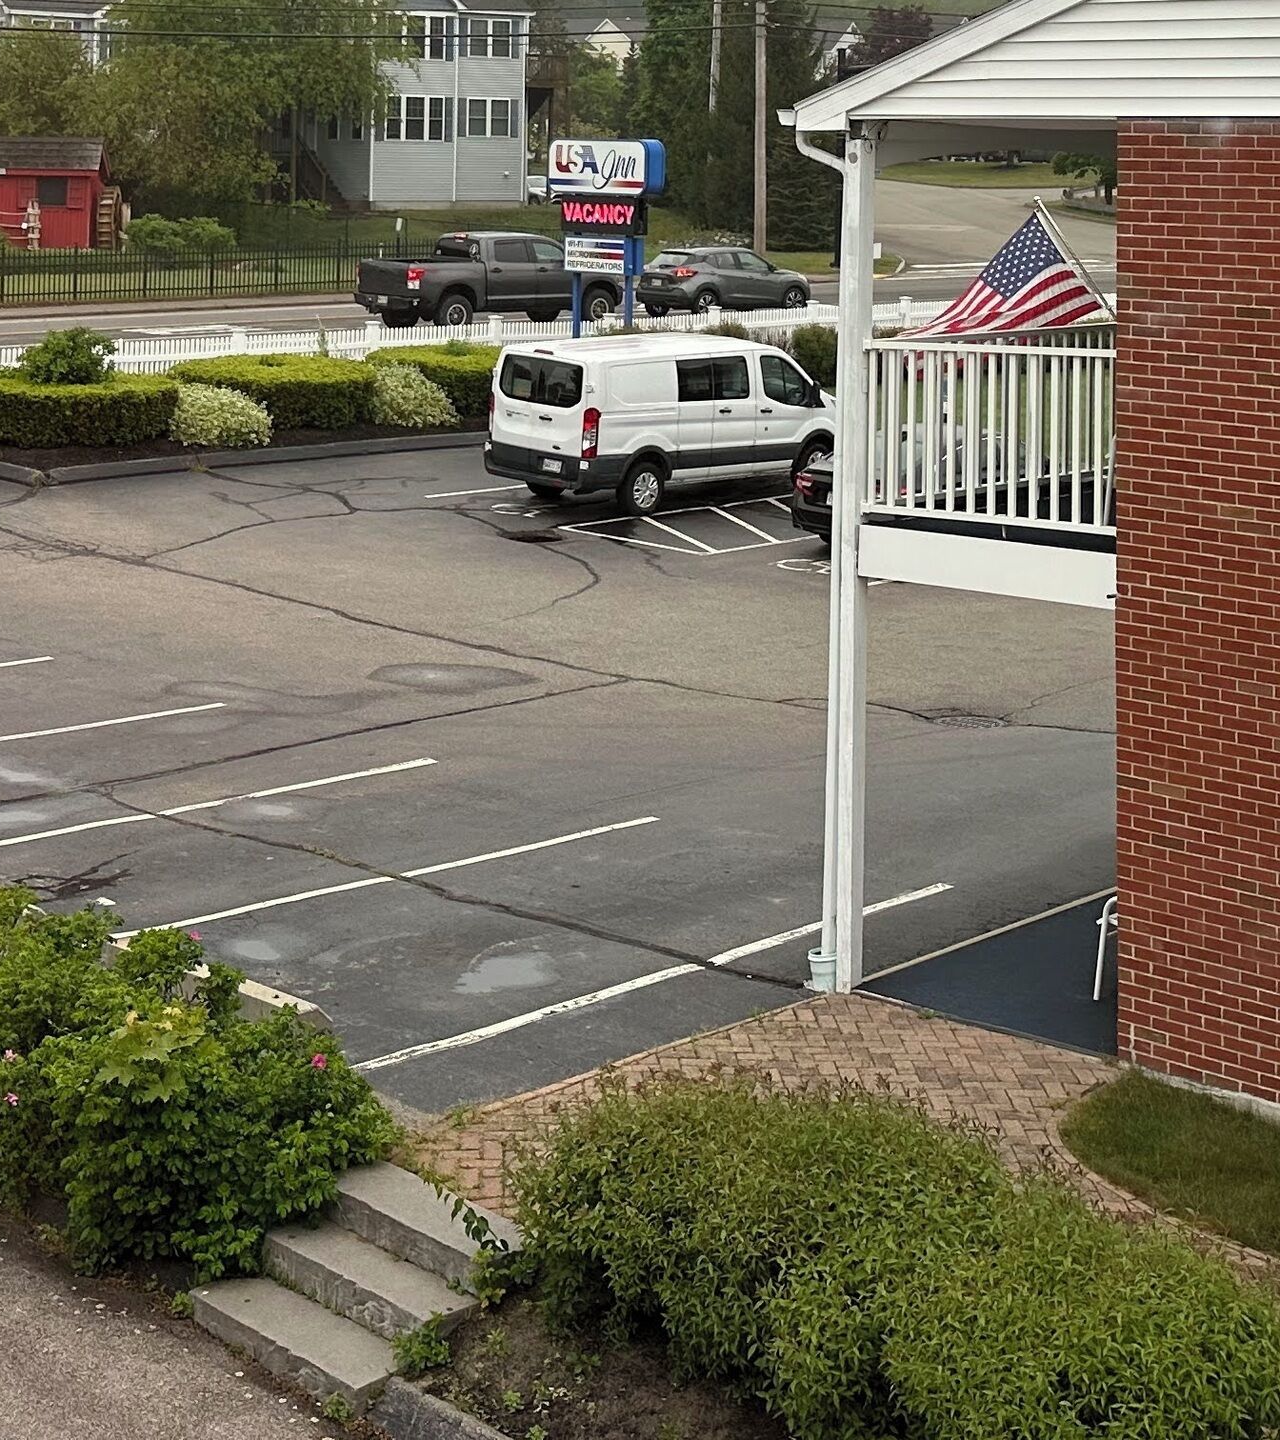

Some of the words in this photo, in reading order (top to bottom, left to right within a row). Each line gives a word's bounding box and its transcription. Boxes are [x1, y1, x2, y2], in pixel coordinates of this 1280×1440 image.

[555, 144, 599, 173] USA
[592, 149, 635, 189] Inn
[563, 202, 635, 225] VACANCY
[567, 249, 612, 260] MICROW
[567, 260, 622, 271] REFRIGERATORS
